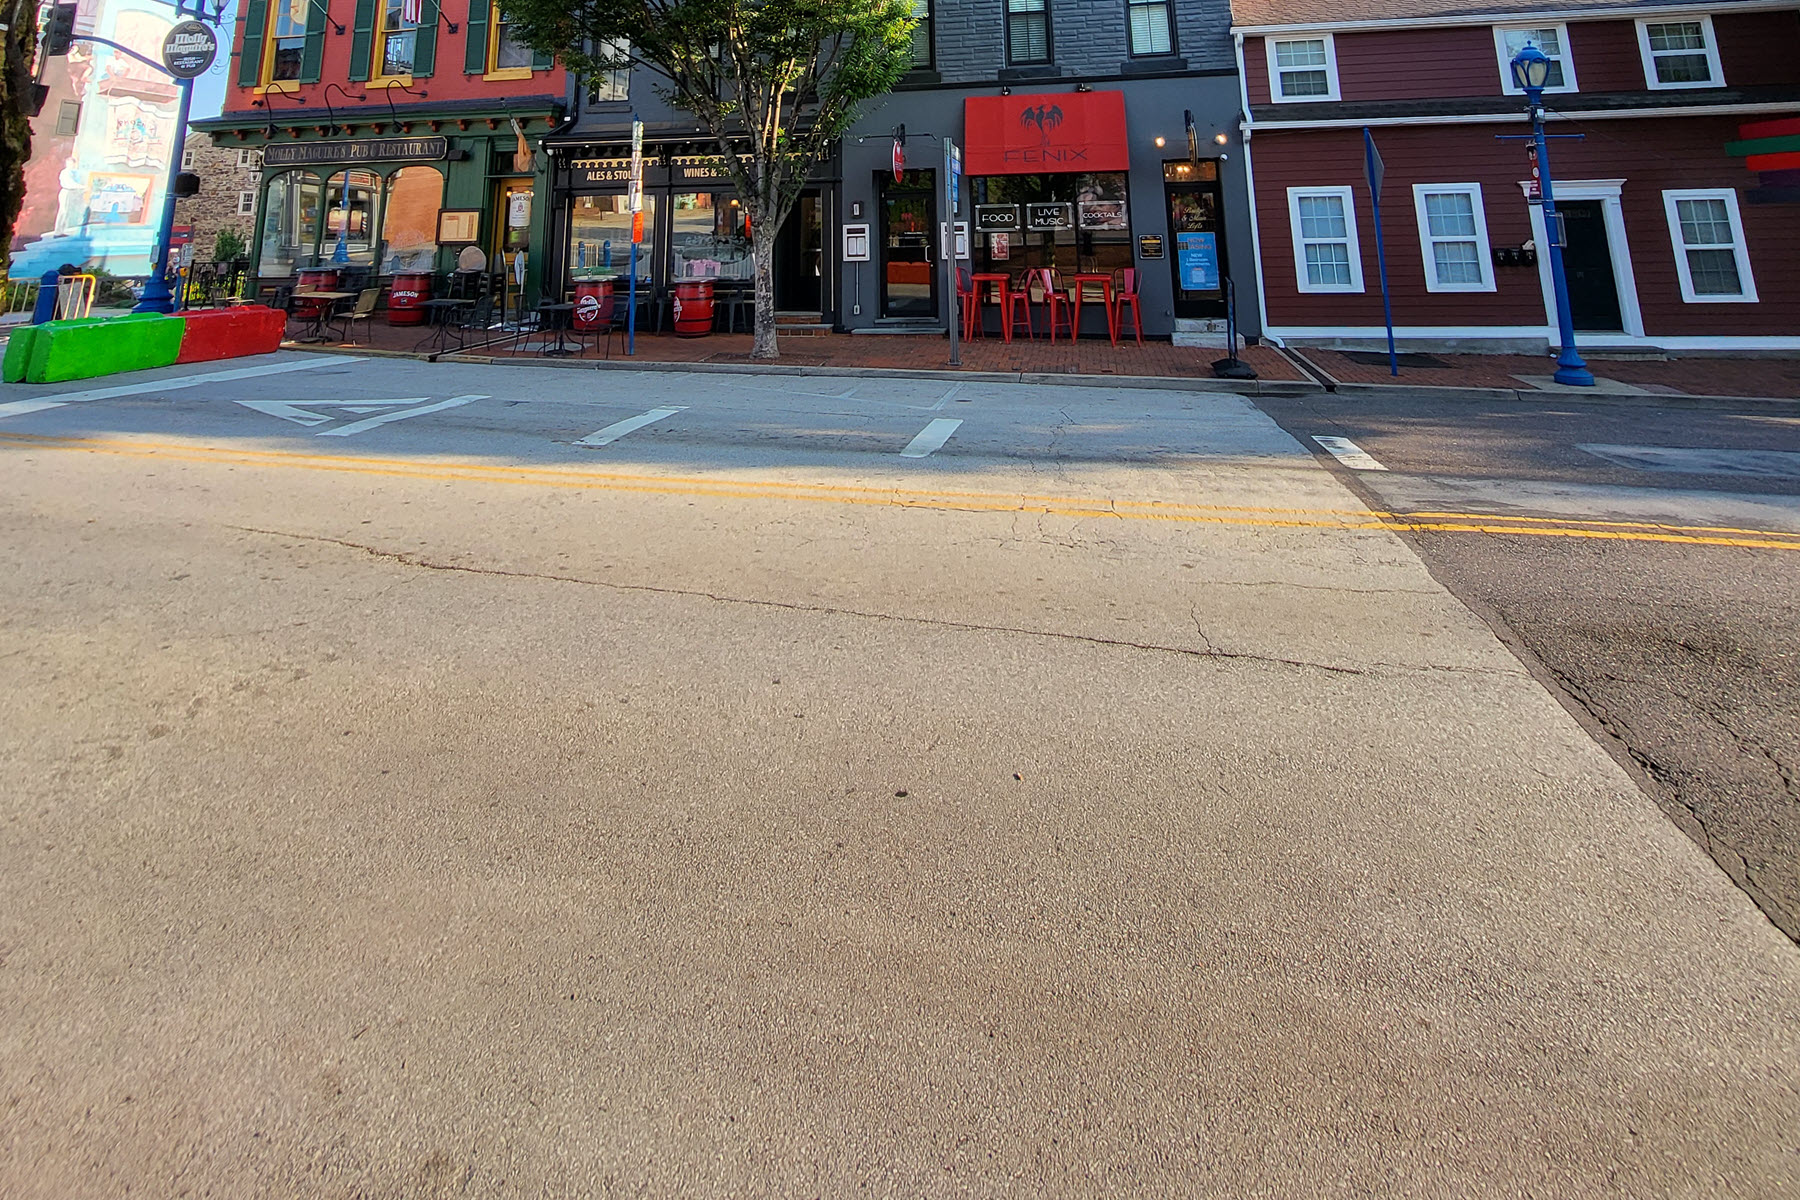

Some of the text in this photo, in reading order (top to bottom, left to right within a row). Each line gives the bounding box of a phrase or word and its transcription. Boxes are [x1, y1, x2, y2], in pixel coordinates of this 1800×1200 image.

[266, 147, 297, 161] MOLLY
[298, 144, 346, 160] MAGUIRE'S
[350, 143, 368, 158] PUB
[378, 141, 443, 157] RESTAURANT
[1004, 148, 1088, 163] FENIX
[586, 170, 633, 181] ALES & STOU
[683, 167, 710, 178] WINES
[710, 167, 717, 177] &
[1037, 207, 1060, 216] LIVE
[1082, 211, 1123, 219] COCKTAILS
[982, 213, 1014, 223] FOOD
[1035, 217, 1065, 226] MUSIC
[392, 290, 420, 299] JAMESON
